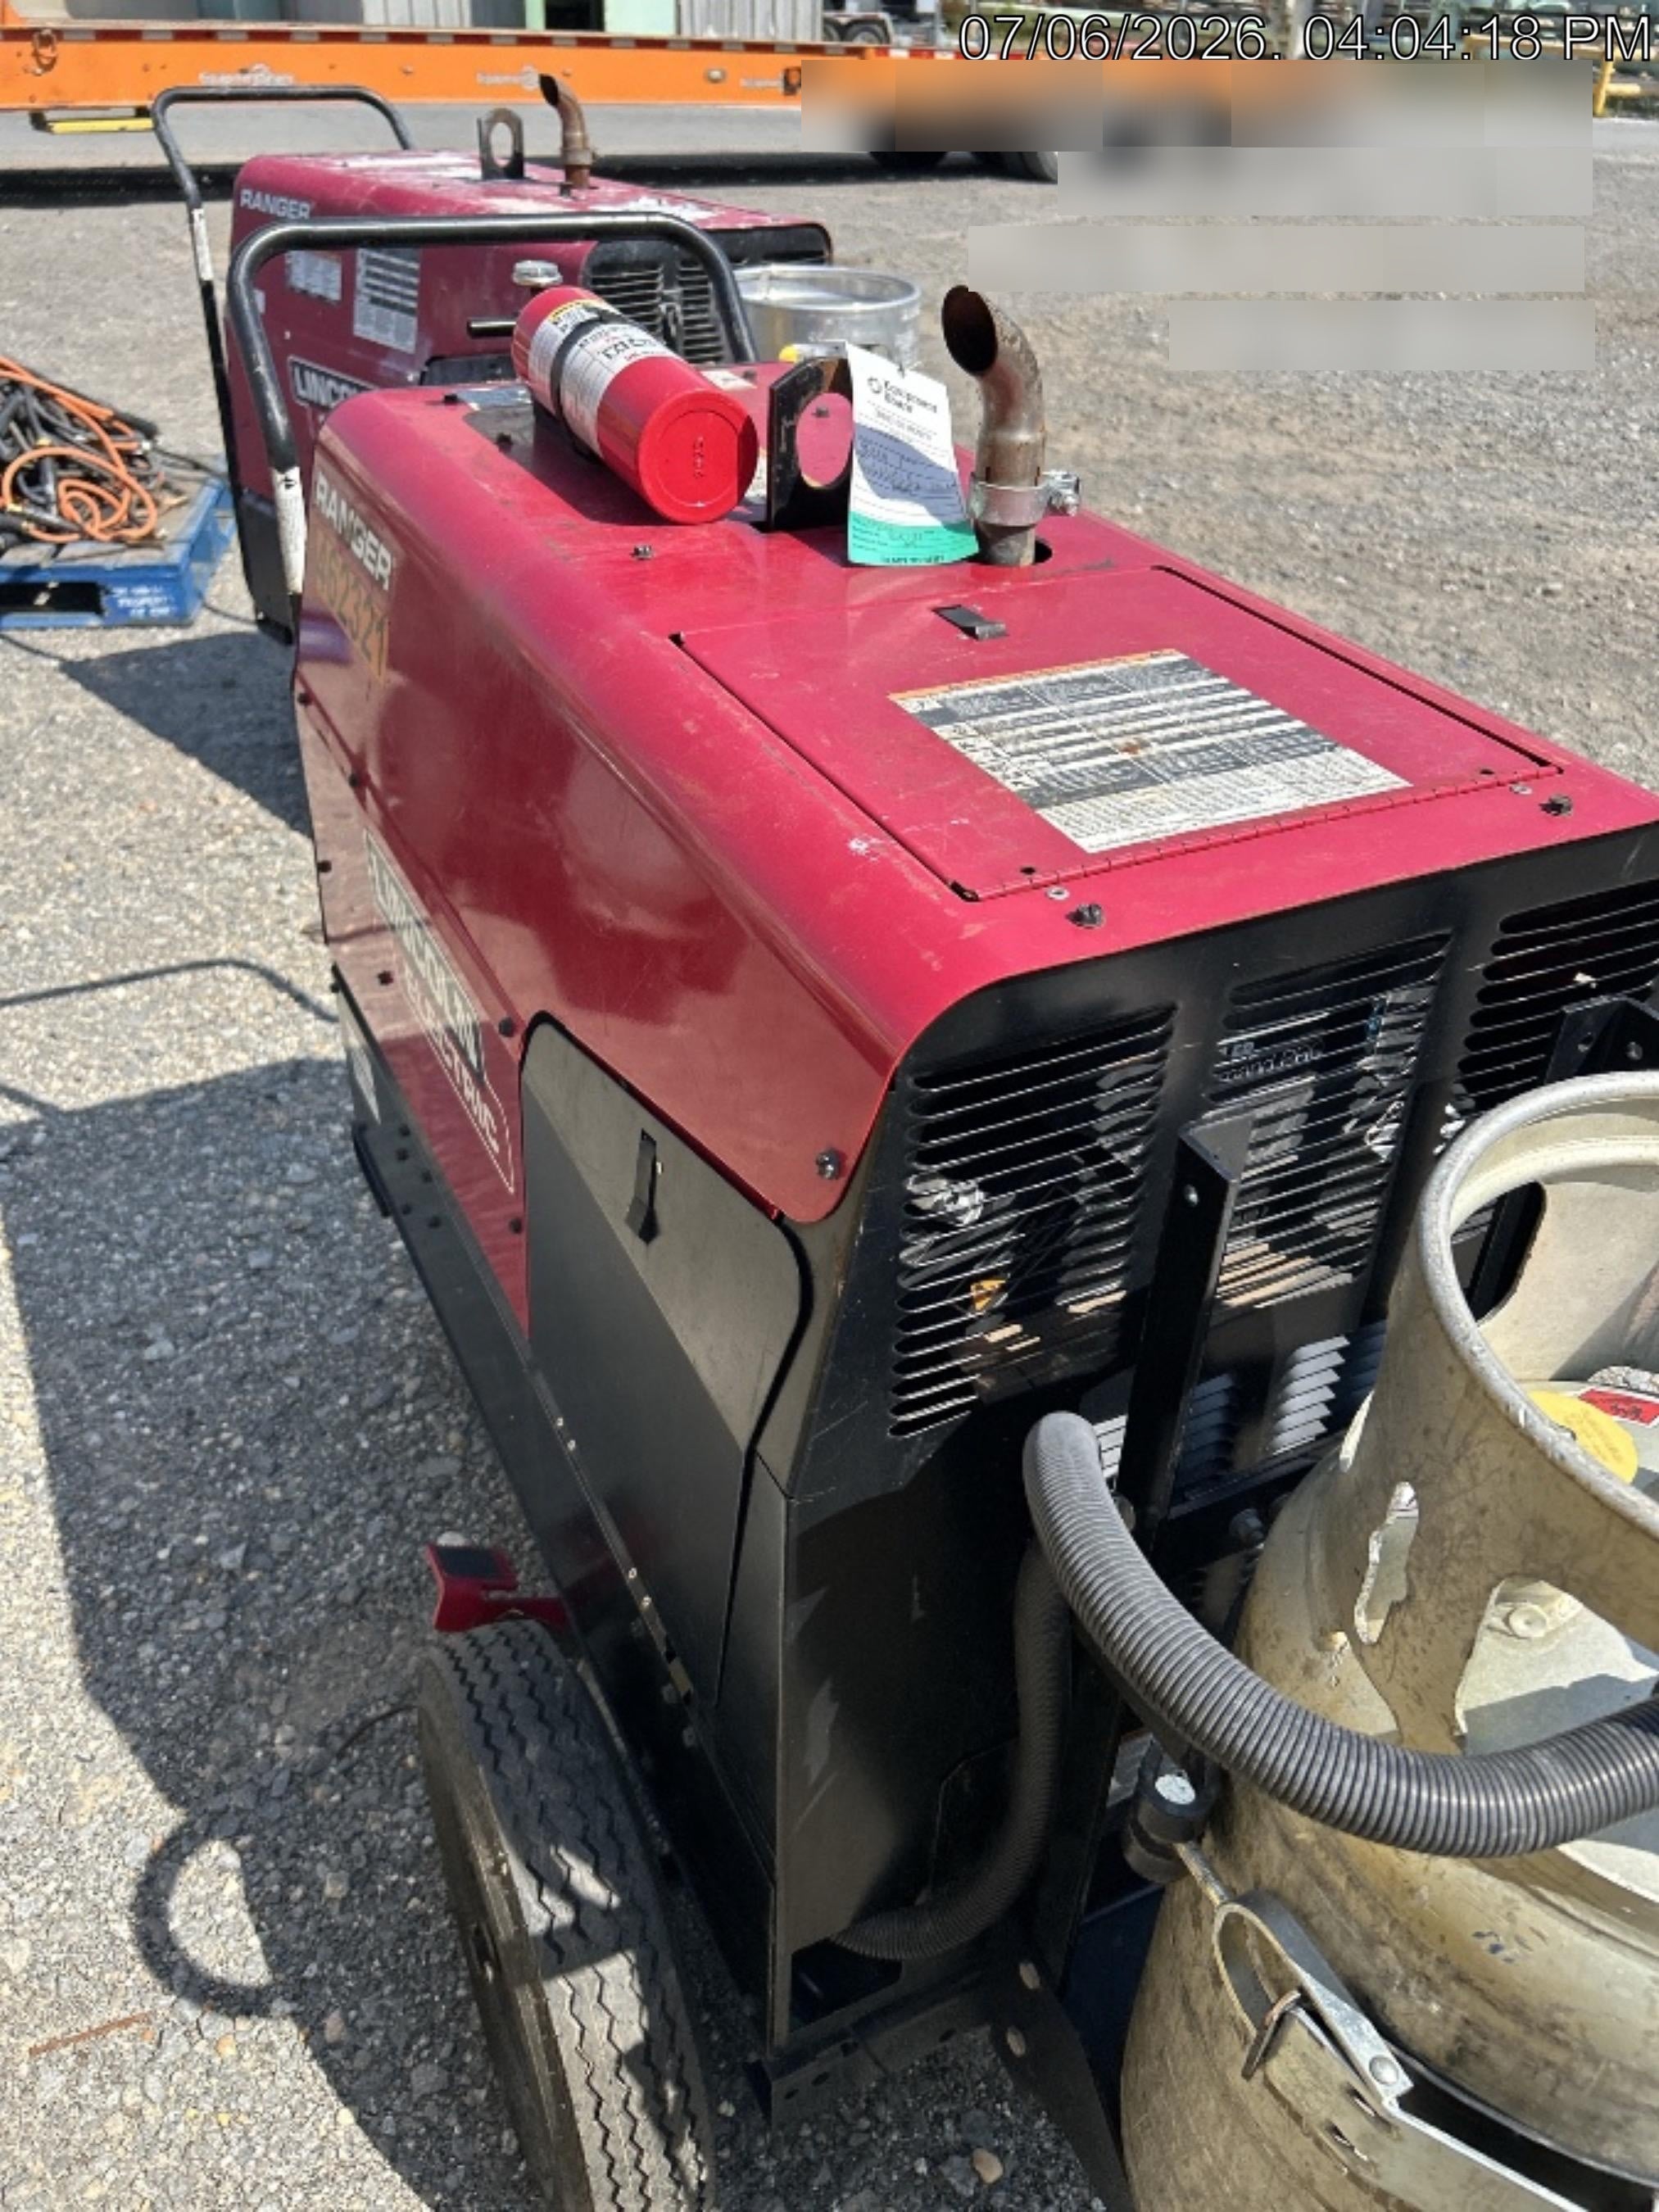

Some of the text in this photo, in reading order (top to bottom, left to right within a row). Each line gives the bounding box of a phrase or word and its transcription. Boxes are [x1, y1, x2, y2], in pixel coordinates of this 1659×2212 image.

[239, 188, 310, 220] RANGER
[315, 469, 392, 591] RANGER
[370, 850, 478, 1071] LINCOLN
[401, 955, 500, 1154] ELECTRIC
